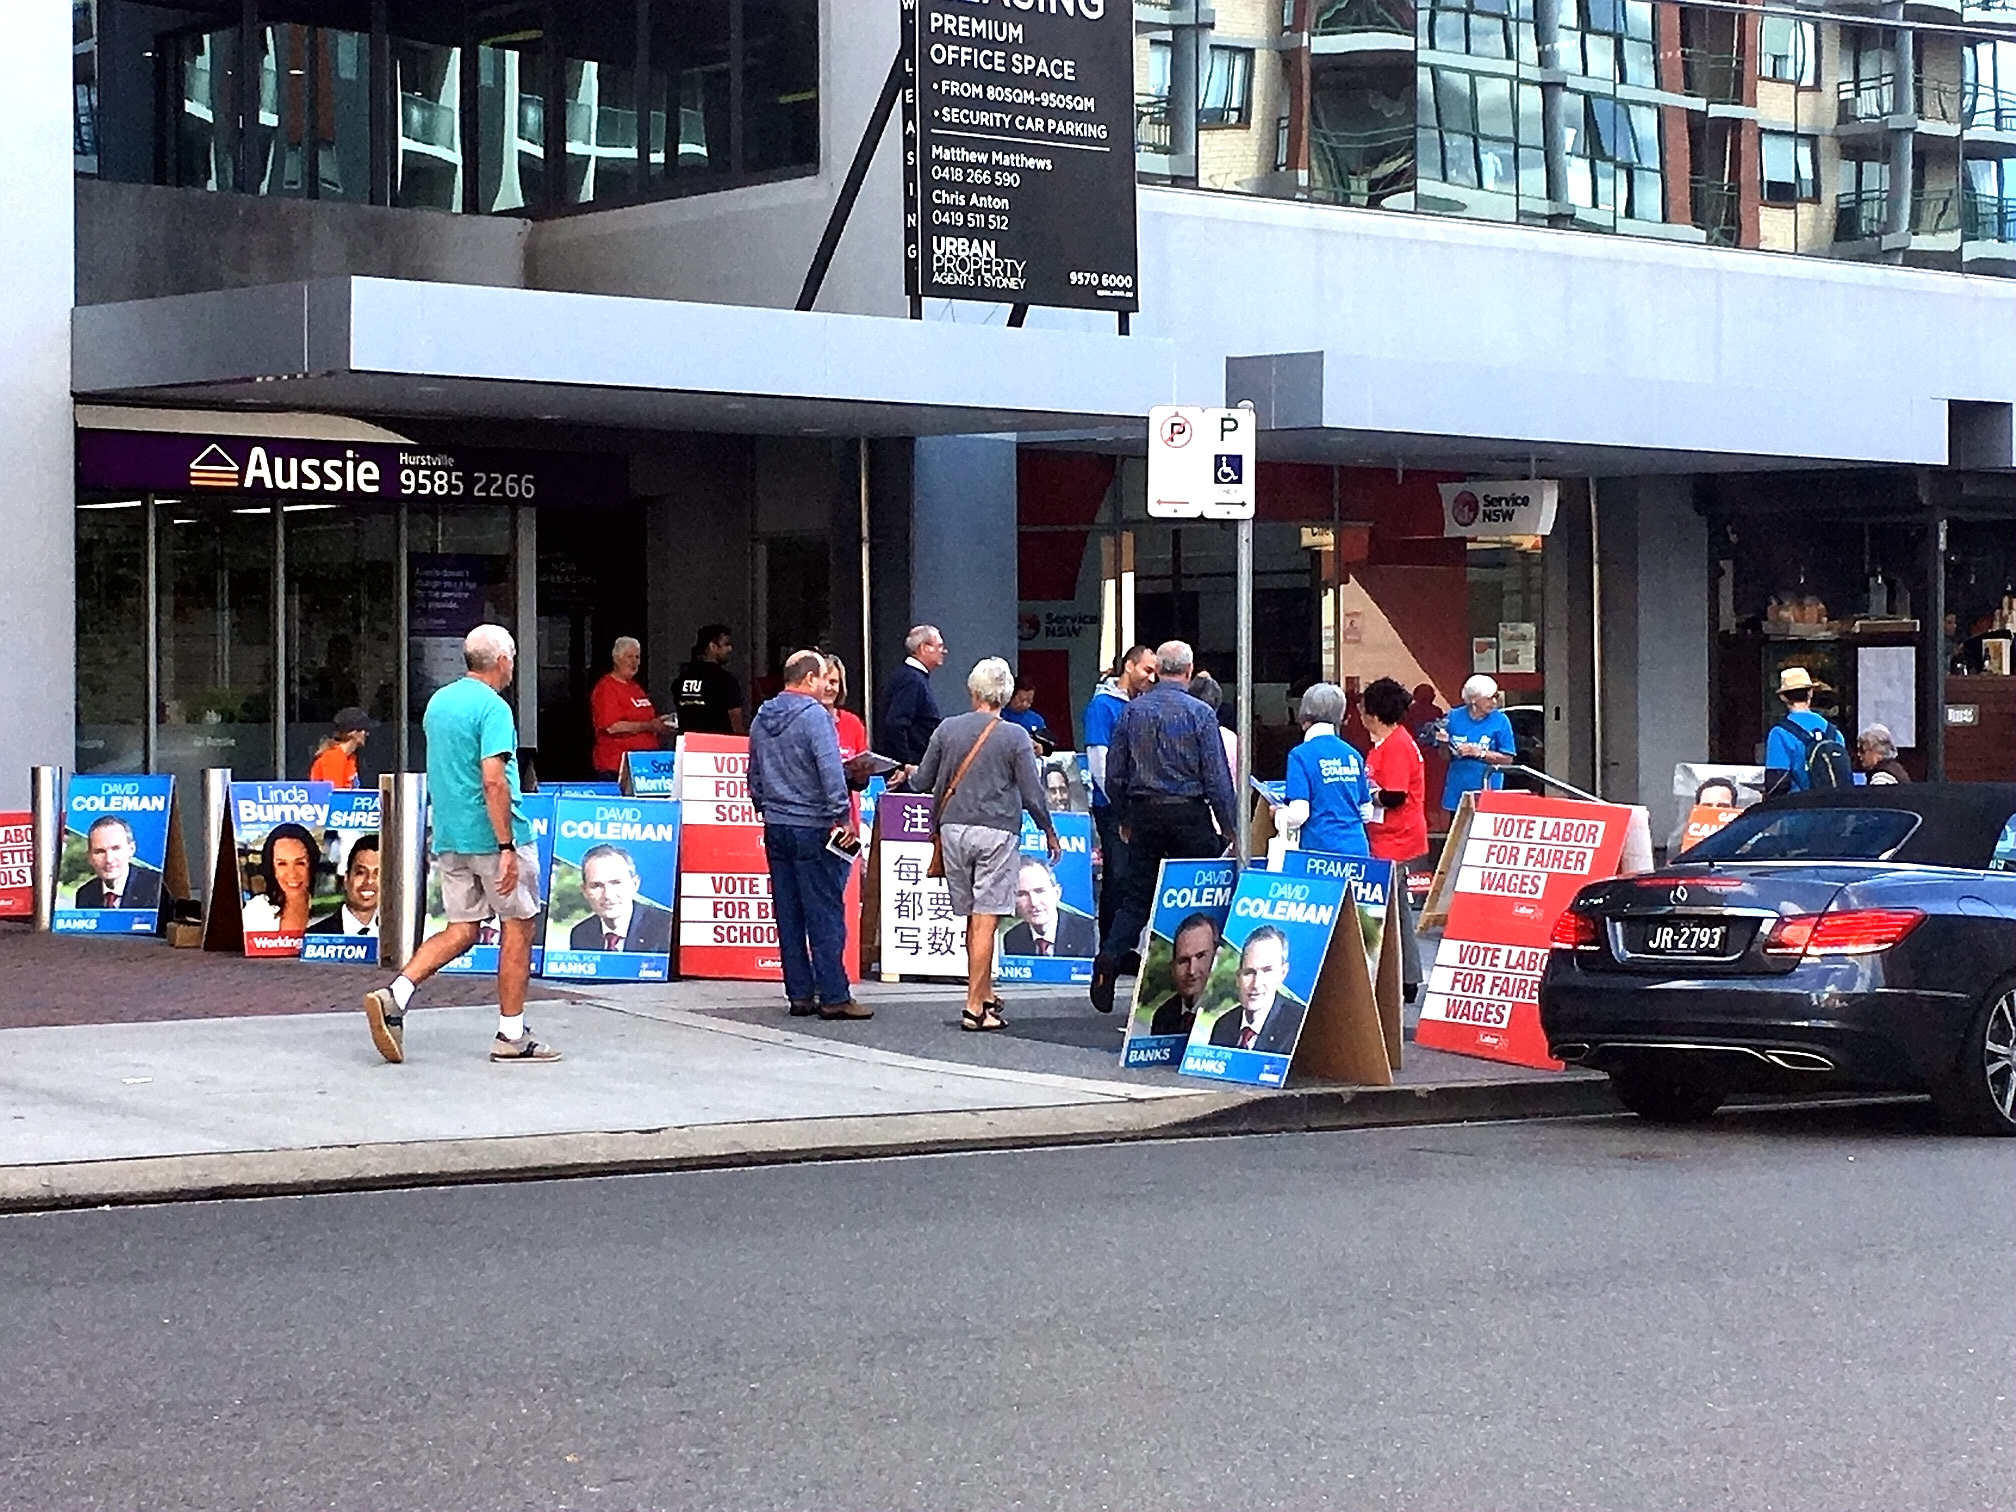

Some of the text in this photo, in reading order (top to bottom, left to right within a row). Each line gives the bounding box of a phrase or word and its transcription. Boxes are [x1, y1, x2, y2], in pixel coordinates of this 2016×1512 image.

[930, 13, 1024, 44] PREMIUM
[930, 43, 1076, 81] OFFICE SPACE
[941, 80, 983, 99] FROM
[942, 107, 1108, 139] SECURITY CAR PARKING
[931, 145, 1053, 171] Matthew Matthews
[931, 165, 1021, 188] 0418 266 590
[931, 189, 1010, 211] Chris Anton
[932, 209, 1009, 230] 0419 511 512
[932, 235, 996, 258] URBAN
[932, 254, 1027, 278] PROPERTY
[932, 272, 976, 287] AGENTS
[984, 276, 1026, 290] SYDNEY
[1069, 271, 1133, 289] 9570 6000
[1220, 417, 1239, 441] P
[244, 446, 380, 493] Aussie
[399, 452, 454, 468] Hurstville
[400, 469, 536, 498] 9585 2266
[1482, 494, 1531, 508] Service
[1482, 509, 1515, 522] NSW
[1045, 612, 1098, 624] Service
[1045, 625, 1082, 637] NSW
[682, 680, 703, 692] ETU
[101, 783, 139, 795] DAVID
[257, 785, 308, 803] Linda
[71, 795, 165, 811] COLEMAN
[596, 807, 641, 821] DAVID
[902, 804, 931, 834] 注
[561, 820, 672, 842] COLEMAN
[1493, 817, 1599, 844] VOTE LABOR
[1485, 844, 1588, 872] FOR FAIRER
[711, 876, 759, 895] VOTE
[1194, 870, 1233, 886] DAVID
[1480, 871, 1542, 895] WAGES
[1268, 881, 1310, 900] DAVID
[713, 901, 750, 919] FOR
[1235, 896, 1333, 926] COLEMAN
[1513, 903, 1536, 916] Labor
[56, 918, 97, 930] BANKS
[894, 925, 966, 956] 写数
[1649, 927, 1722, 949] JR-2793
[304, 945, 367, 960] BARTON
[1457, 943, 1502, 966] VOTE
[548, 962, 597, 975] BANKS
[1450, 971, 1485, 993] FOR
[1444, 997, 1506, 1025] WAGES
[1478, 1031, 1501, 1044] Labor
[1129, 1047, 1170, 1063] BANKS
[1184, 1056, 1227, 1074] BANKS
